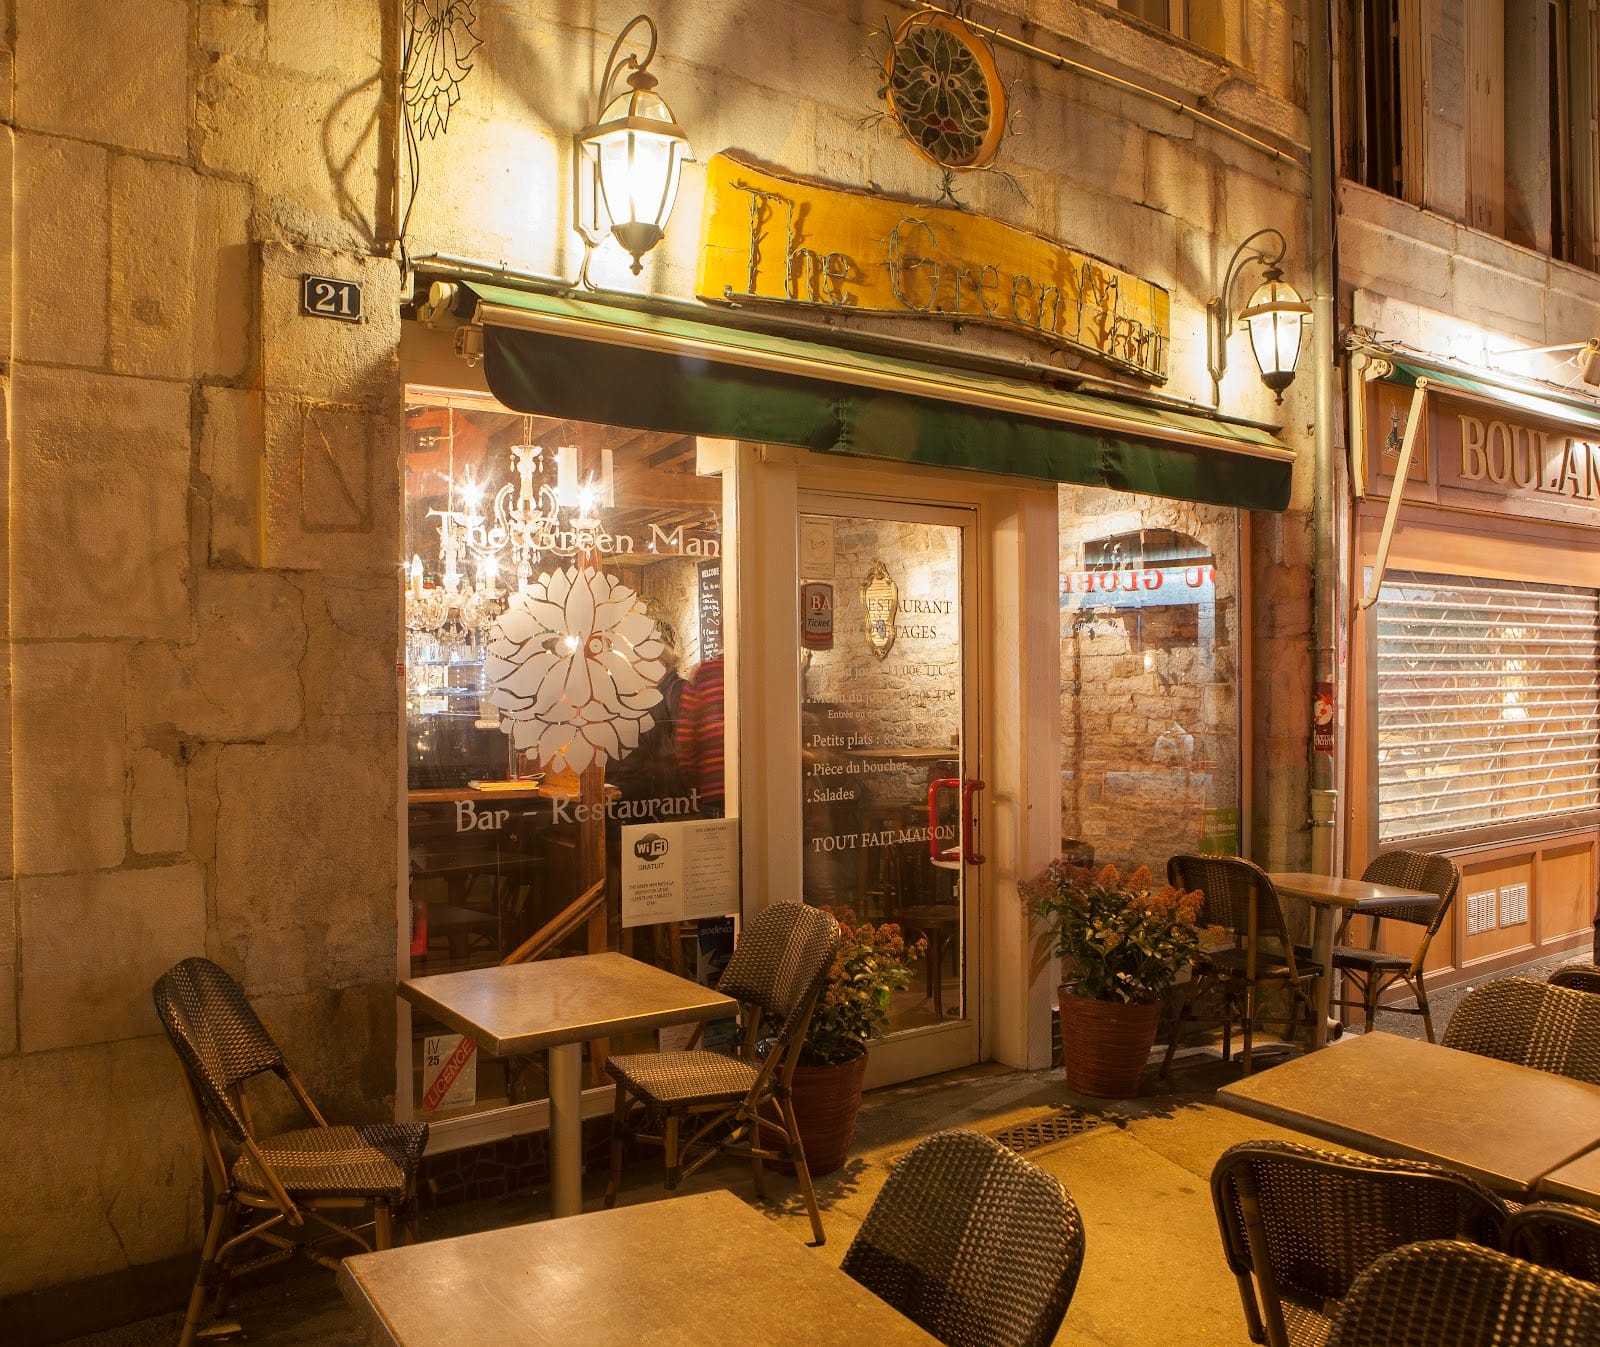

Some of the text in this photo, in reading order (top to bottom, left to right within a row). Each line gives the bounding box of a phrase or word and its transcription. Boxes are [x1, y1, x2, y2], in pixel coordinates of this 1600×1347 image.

[729, 181, 1161, 374] The Green Man
[315, 283, 351, 314] 21
[1458, 414, 1600, 500] BOULAN
[425, 506, 721, 557] The Green Man
[807, 618, 831, 629] Ticket
[828, 709, 854, 719] Entrée
[812, 734, 845, 748] Petits
[847, 732, 873, 750] plats
[813, 762, 844, 777] Pièce
[846, 760, 861, 775] du
[813, 787, 855, 804] Salades
[454, 799, 510, 833] Bar
[552, 788, 702, 825] Restaurant
[812, 824, 956, 853] TOUT FAIT MAISON
[638, 862, 665, 872] GRATUIT
[428, 1039, 440, 1055] IV
[427, 1055, 440, 1066] 25
[428, 1039, 473, 1107] LICENCE
